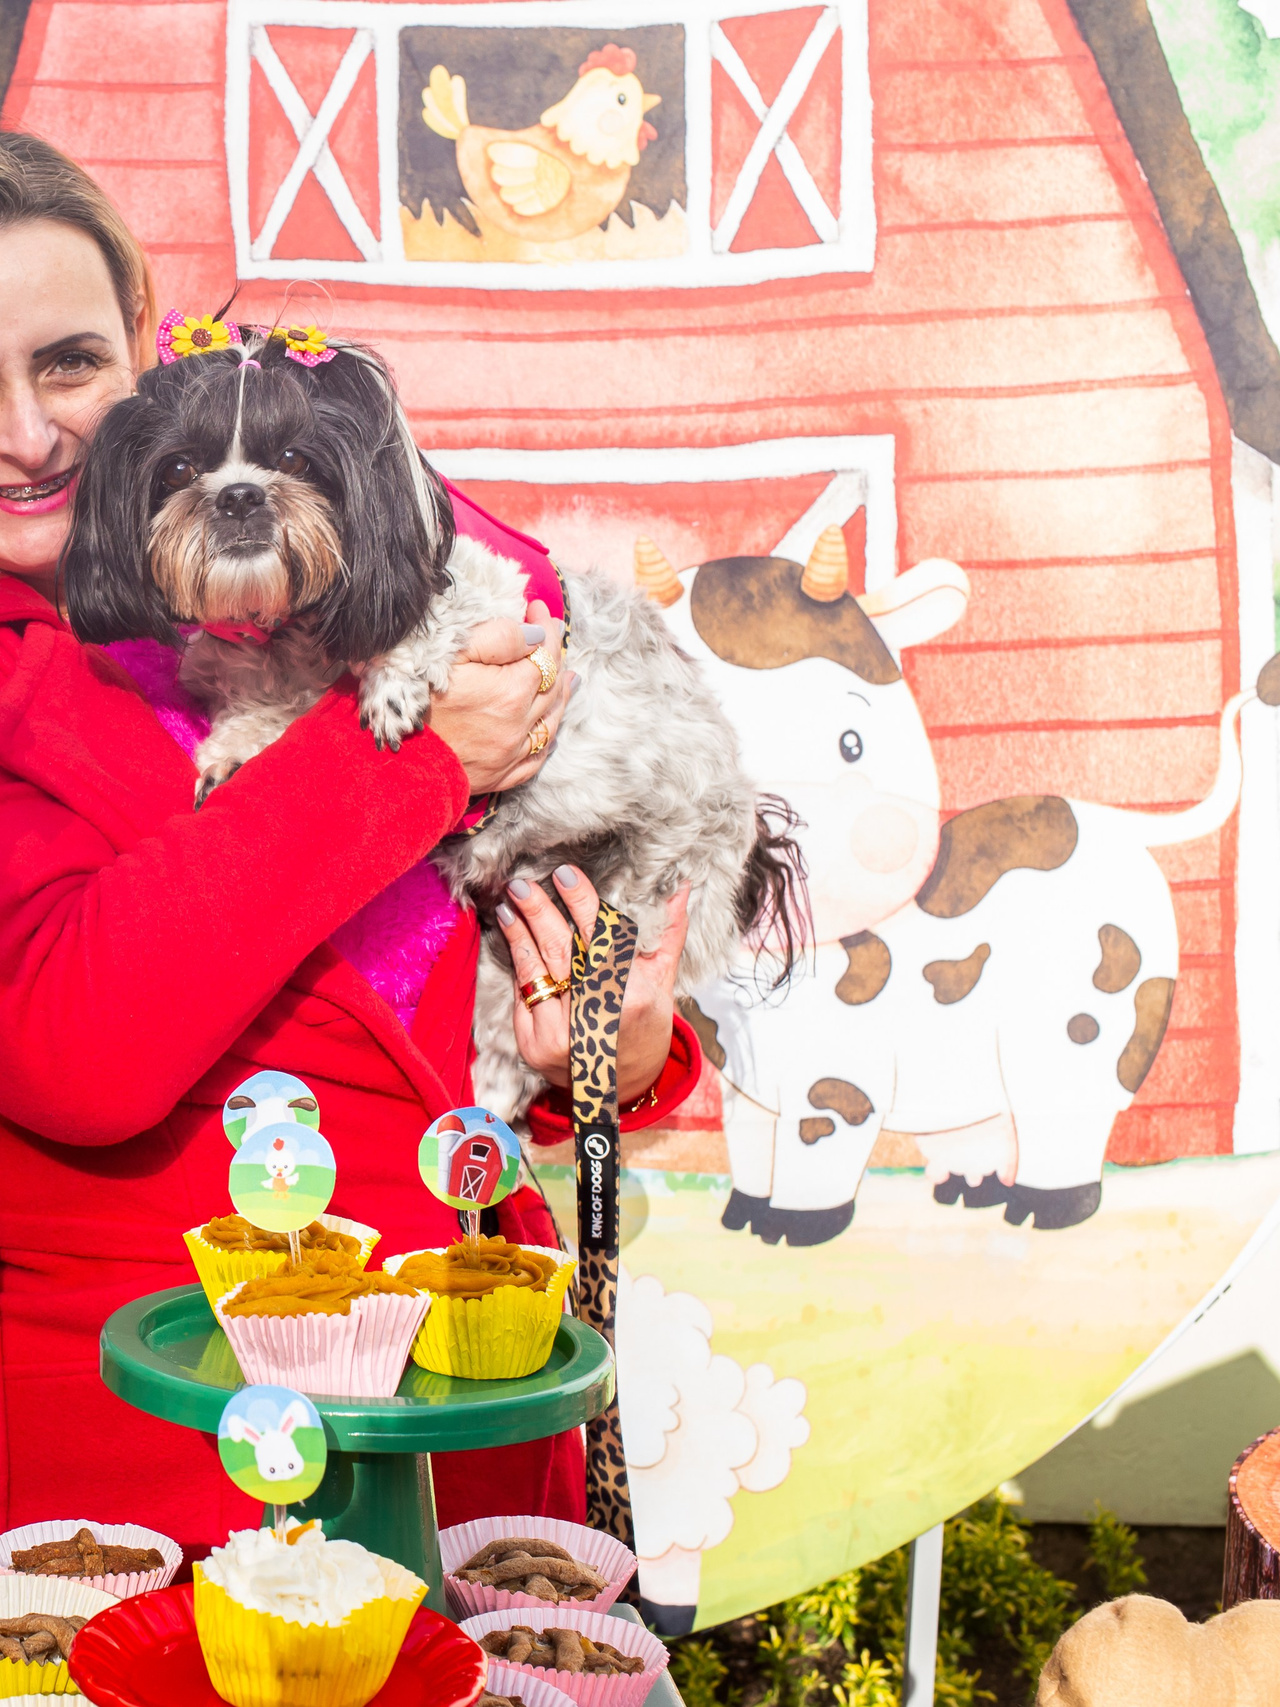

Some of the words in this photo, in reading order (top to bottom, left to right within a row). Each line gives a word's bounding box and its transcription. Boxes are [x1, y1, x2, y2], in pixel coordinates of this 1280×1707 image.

[591, 1160, 603, 1194] DOGS
[592, 1194, 603, 1212] OF
[592, 1212, 603, 1239] KING
